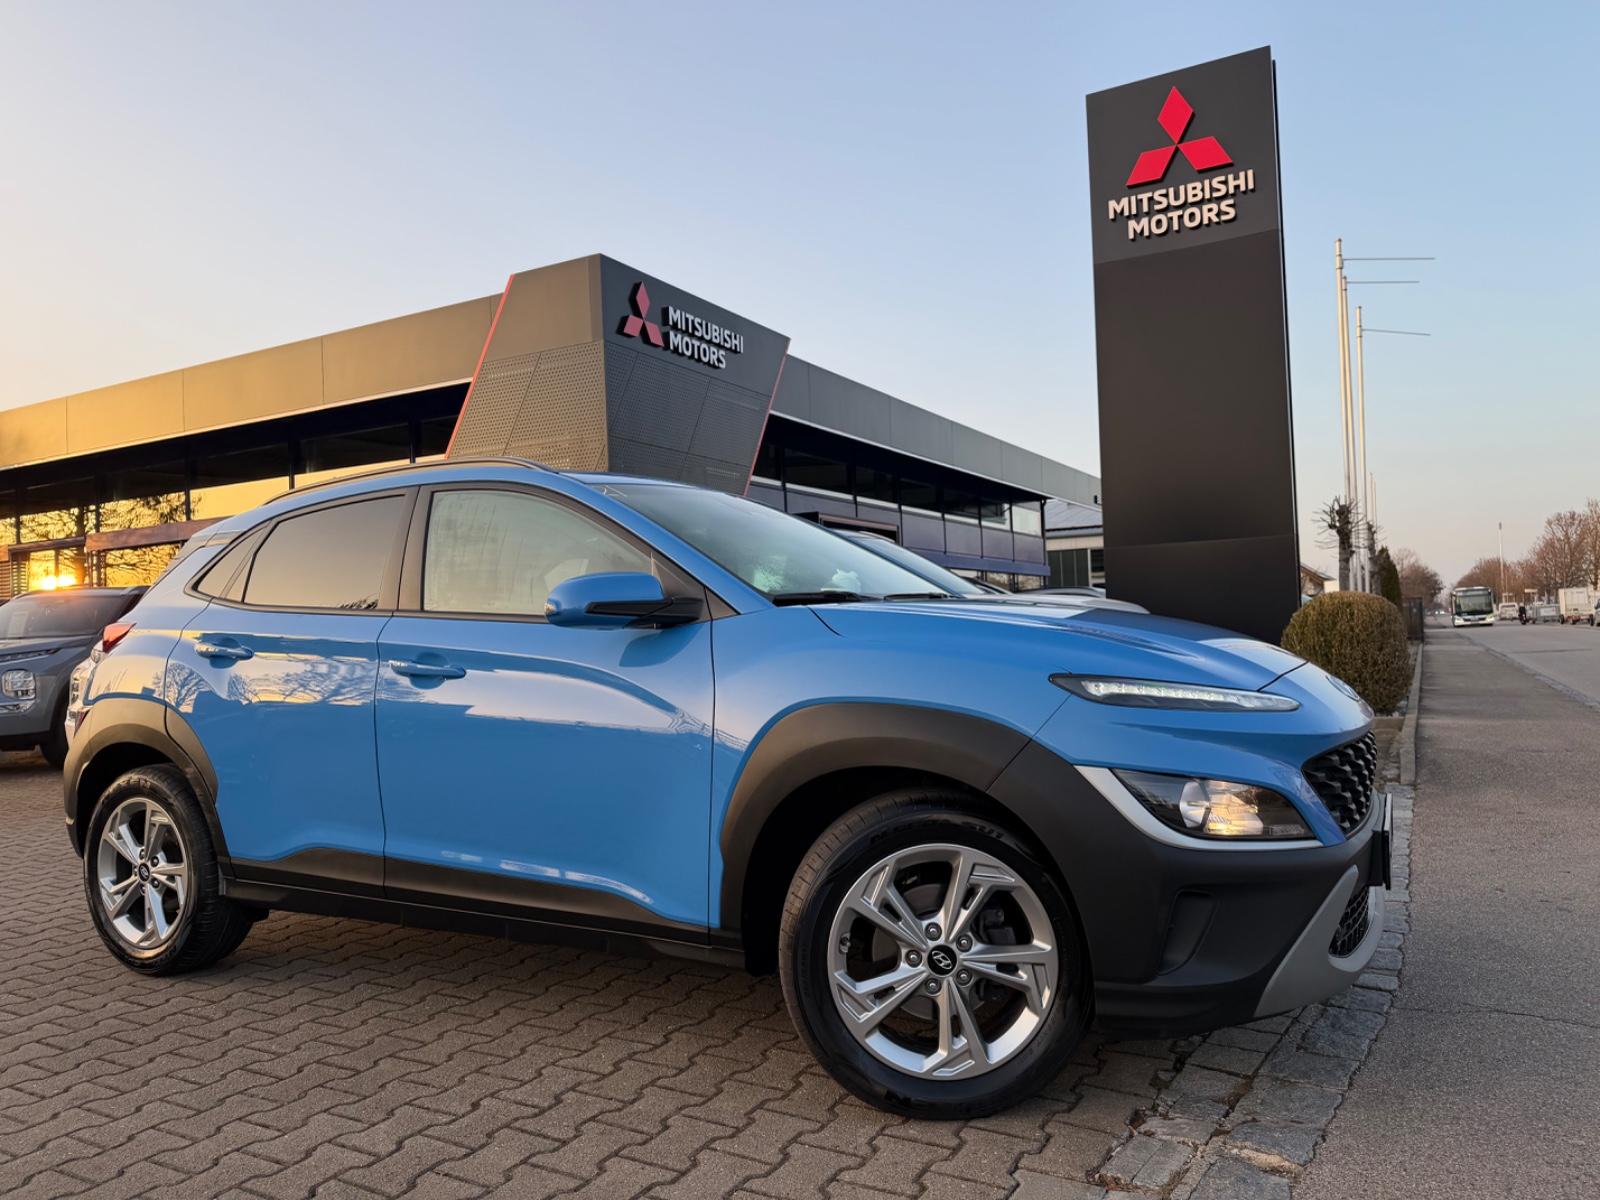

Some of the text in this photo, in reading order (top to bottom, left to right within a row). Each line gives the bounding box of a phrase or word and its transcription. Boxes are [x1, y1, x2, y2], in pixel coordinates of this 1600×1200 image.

[1108, 169, 1254, 219] MITSUBISHI
[1128, 199, 1236, 239] MOTORS
[668, 306, 743, 353] MITSUBISHI
[669, 330, 726, 368] MOTORS
